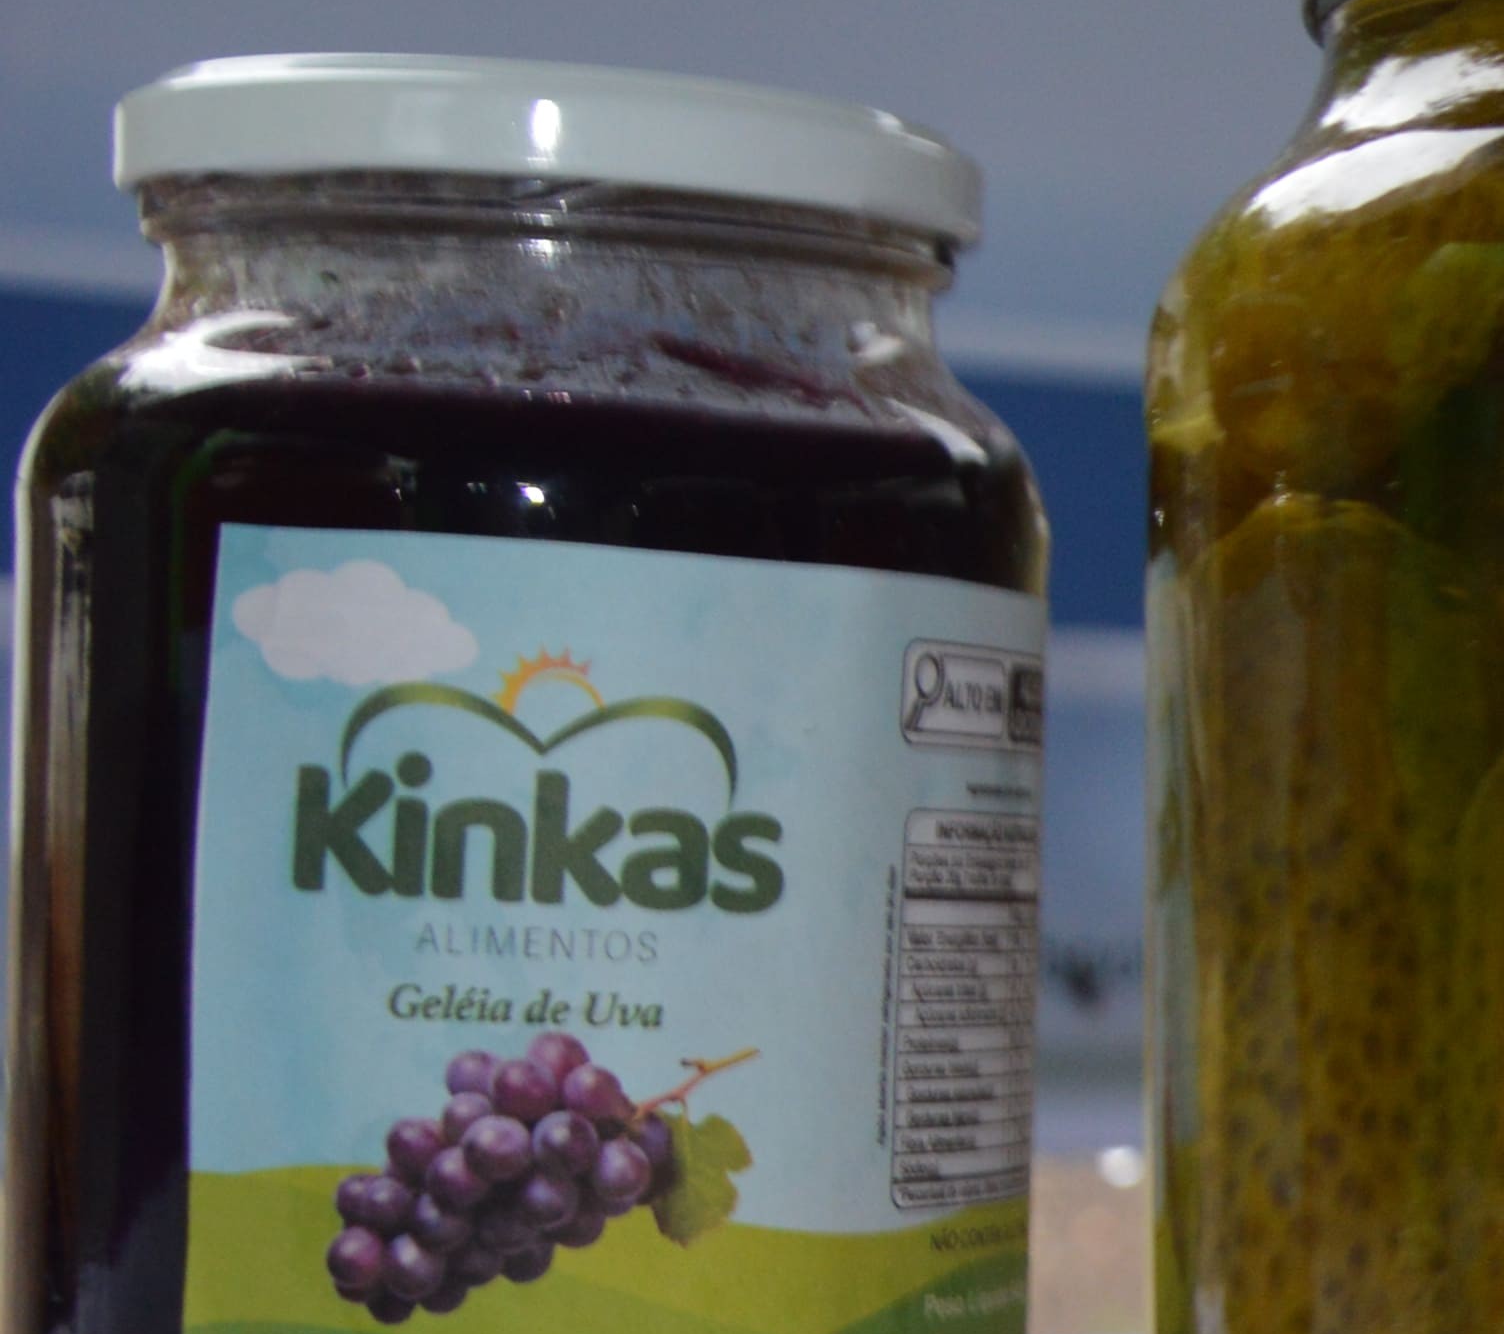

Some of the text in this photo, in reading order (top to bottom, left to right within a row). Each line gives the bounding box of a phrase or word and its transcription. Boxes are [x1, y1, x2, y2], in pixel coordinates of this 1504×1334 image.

[291, 752, 784, 915] Kinkas
[414, 922, 660, 964] ALIMENTOS
[388, 981, 665, 1031] Geléia de Uva
